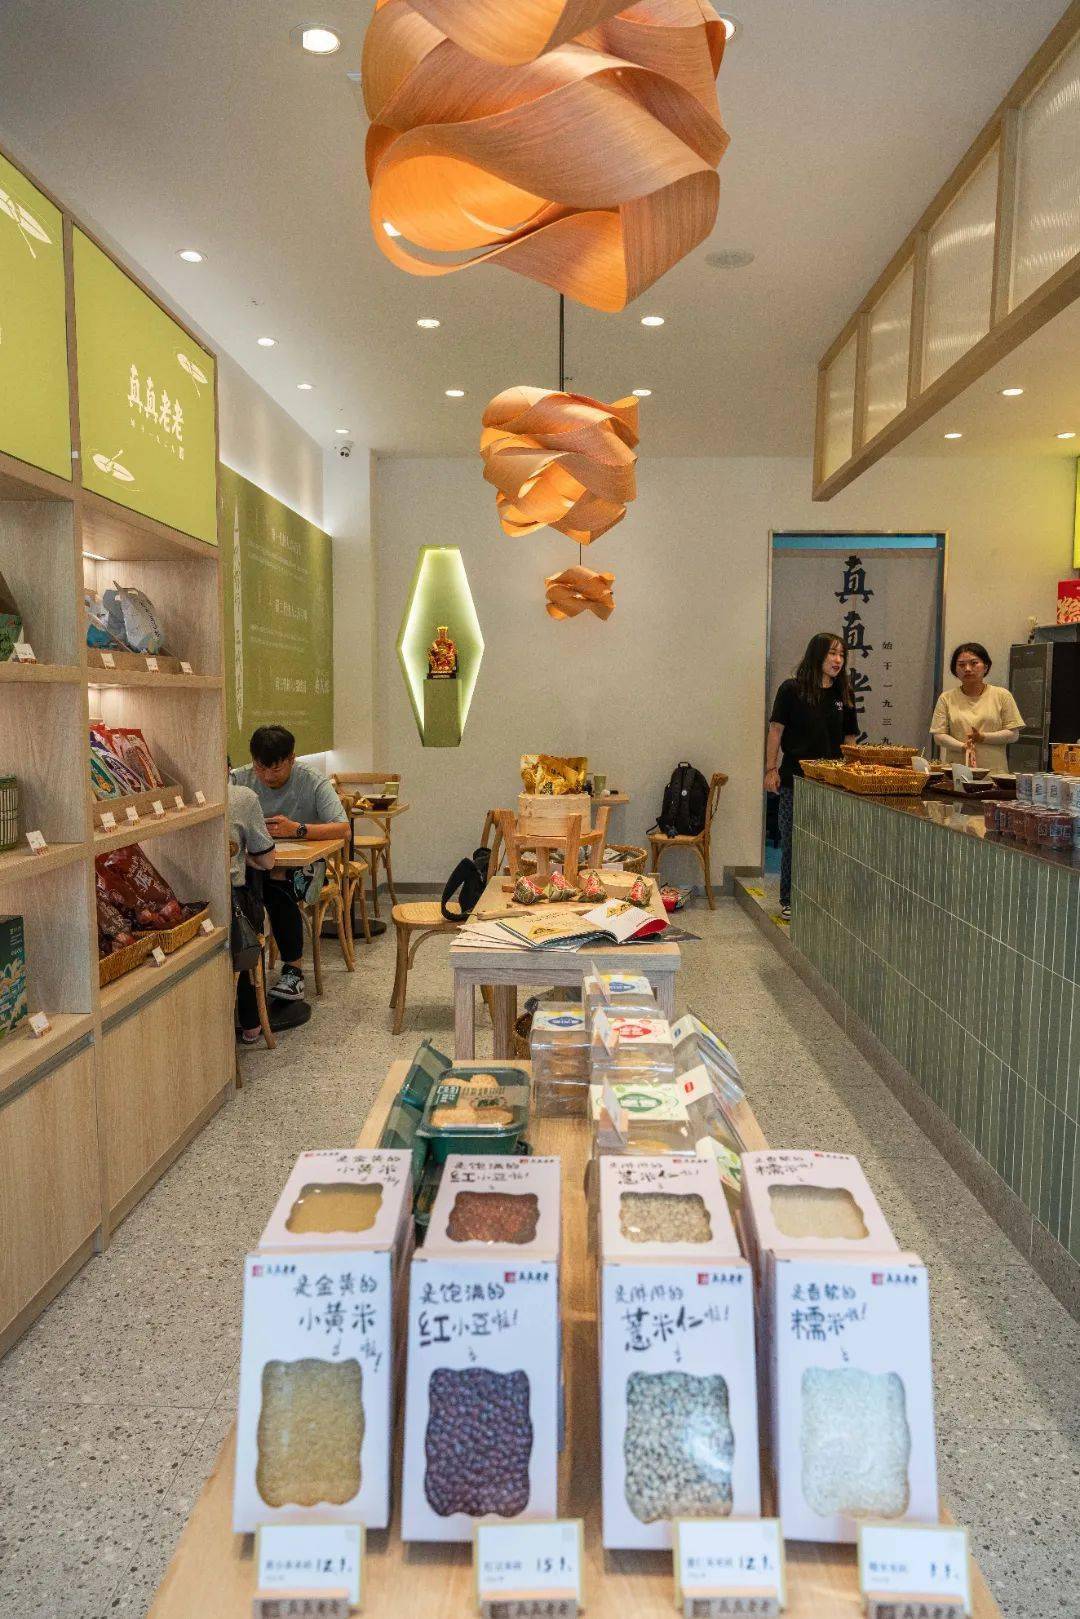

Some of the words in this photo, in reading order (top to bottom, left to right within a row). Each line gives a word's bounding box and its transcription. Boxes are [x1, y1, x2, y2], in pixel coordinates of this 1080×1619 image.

[127, 364, 184, 442] 真真老老
[298, 1301, 376, 1334] 小黄米
